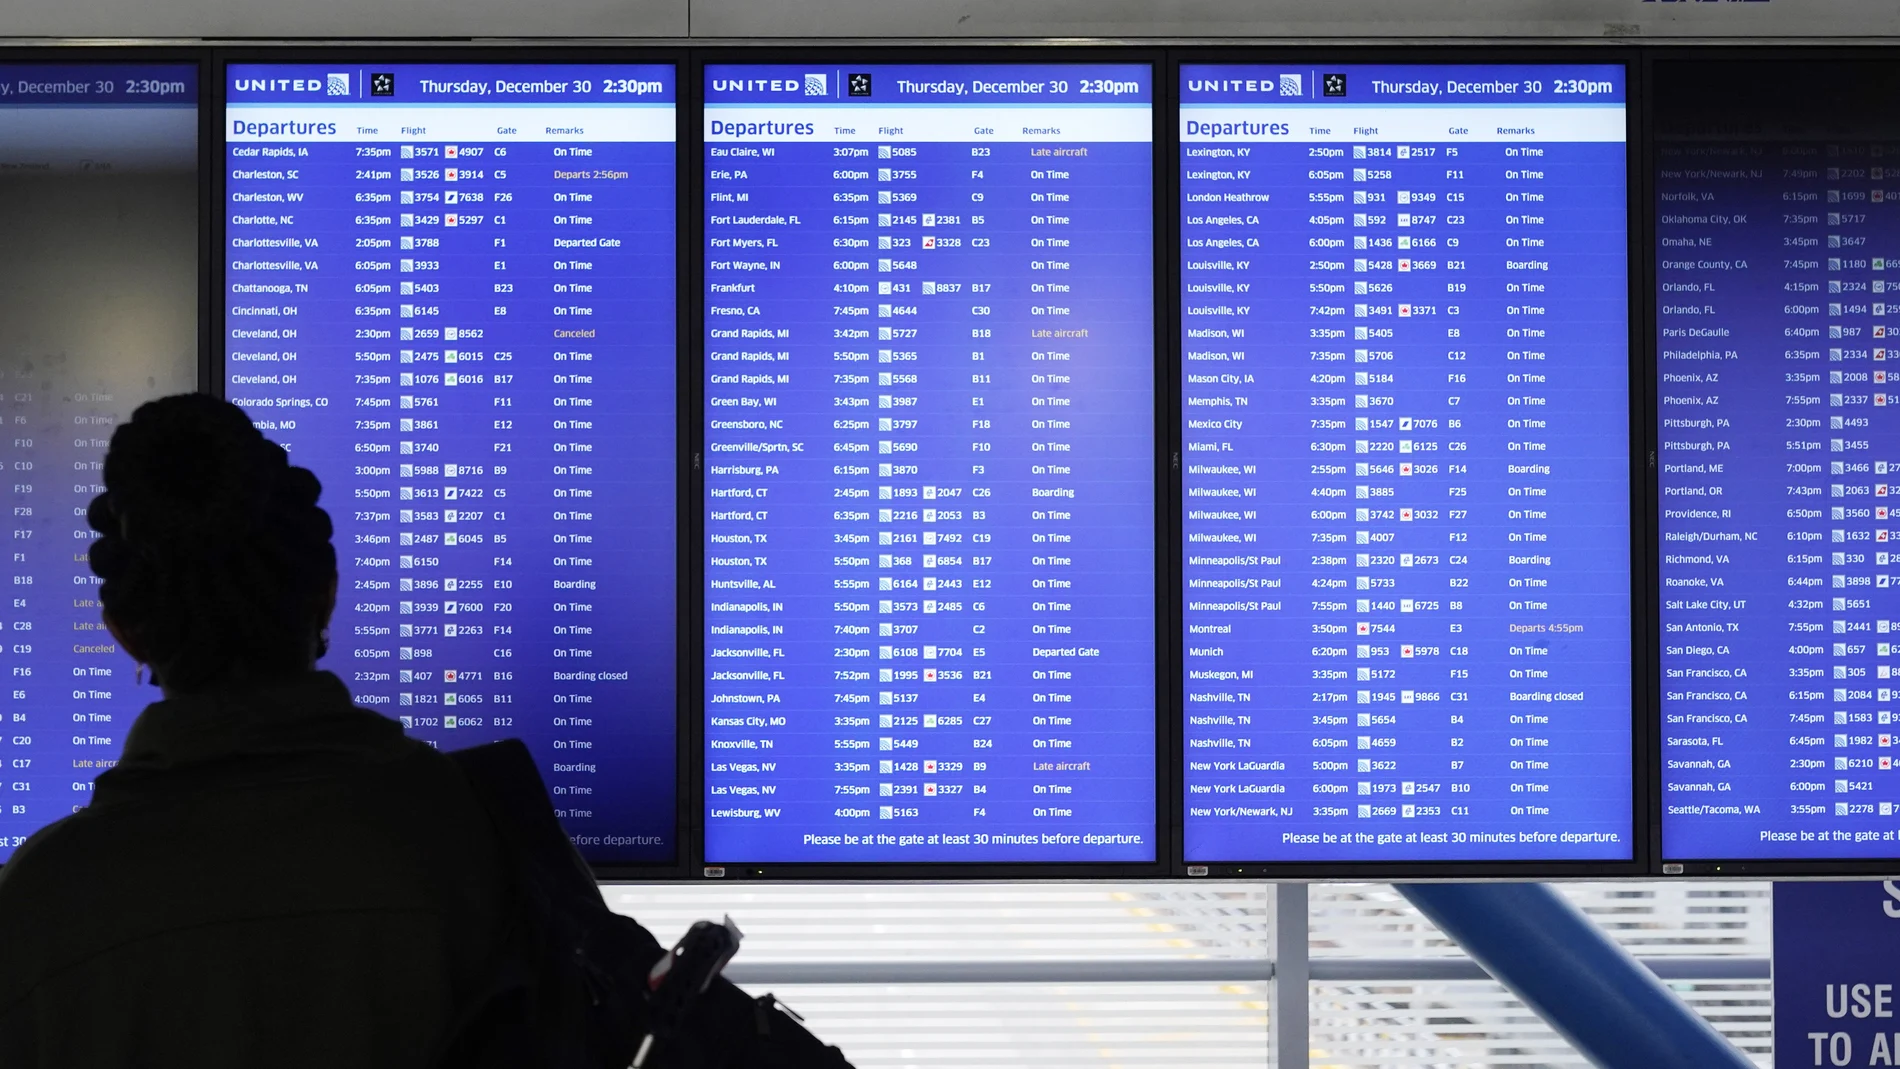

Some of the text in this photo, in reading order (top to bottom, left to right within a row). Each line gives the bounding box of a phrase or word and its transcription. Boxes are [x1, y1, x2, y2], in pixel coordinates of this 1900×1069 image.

[18, 79, 90, 94] December
[96, 80, 114, 94] 30
[126, 79, 184, 96] 2:30pm
[236, 79, 322, 92] UNITED
[420, 79, 662, 96] Thursday, December 30 2:30pm
[712, 79, 800, 92] UNITED
[896, 79, 1138, 96] Thursday, December 30 2:30pm
[1188, 80, 1274, 92] UNITED
[1372, 79, 1612, 96] Thursday, December 30 2:30pm
[234, 120, 336, 138] Departures
[356, 126, 584, 136] Time Flight Gate Remarks
[712, 120, 814, 138] Departures
[878, 126, 904, 136] Flight
[974, 126, 994, 135] Gate
[1186, 120, 1290, 138] Departures
[1354, 126, 1378, 136] Flight
[1496, 126, 1536, 135] Remarks
[232, 146, 592, 158] Cedar Rapids, IA 7:35pm 3571 4907 C6 On Time
[710, 147, 1088, 158] Eau Claire, WI 3:07pm 5085 B23 Late aircraft
[232, 169, 628, 181] Charleston, SC 2:41pm 3526 3914 C5 Departs 2:56pm
[1186, 192, 1544, 204] London Heathrow 5:55pm 931 9349 C15 On Time
[1662, 191, 1866, 202] Norfolk, VA 6:15pm 1699
[710, 555, 1072, 567] Houston, TX 5:50pm 368 6854 B17 On Time
[1190, 554, 1550, 567] Minneapolis/St Paul 2:38pm 2320 2673 C24 Boarding
[354, 579, 596, 591] 2:45pm 3896 2255 E10 Boarding
[1666, 599, 1870, 611] Salt Lake City, UT 4:32pm 5651
[1190, 623, 1584, 635] Montreal 3:50pm 7544 E3 Departs 4:55pm
[14, 644, 114, 654] C19 Canceled
[354, 670, 628, 682] 2:32pm 407 4771 B16 Boarding closed
[1668, 781, 1872, 793] Savannah, GA 6:00pm 5421
[570, 834, 664, 847] efore departure.
[804, 832, 1144, 847] Please be at the gate at least 30 minutes before departure.
[1282, 831, 1620, 845] Please be at the gate at least 30 minutes before departure.
[1760, 829, 1894, 843] Please be at the gate at
[1826, 983, 1892, 1019] USE
[1808, 1031, 1900, 1067] TO A
